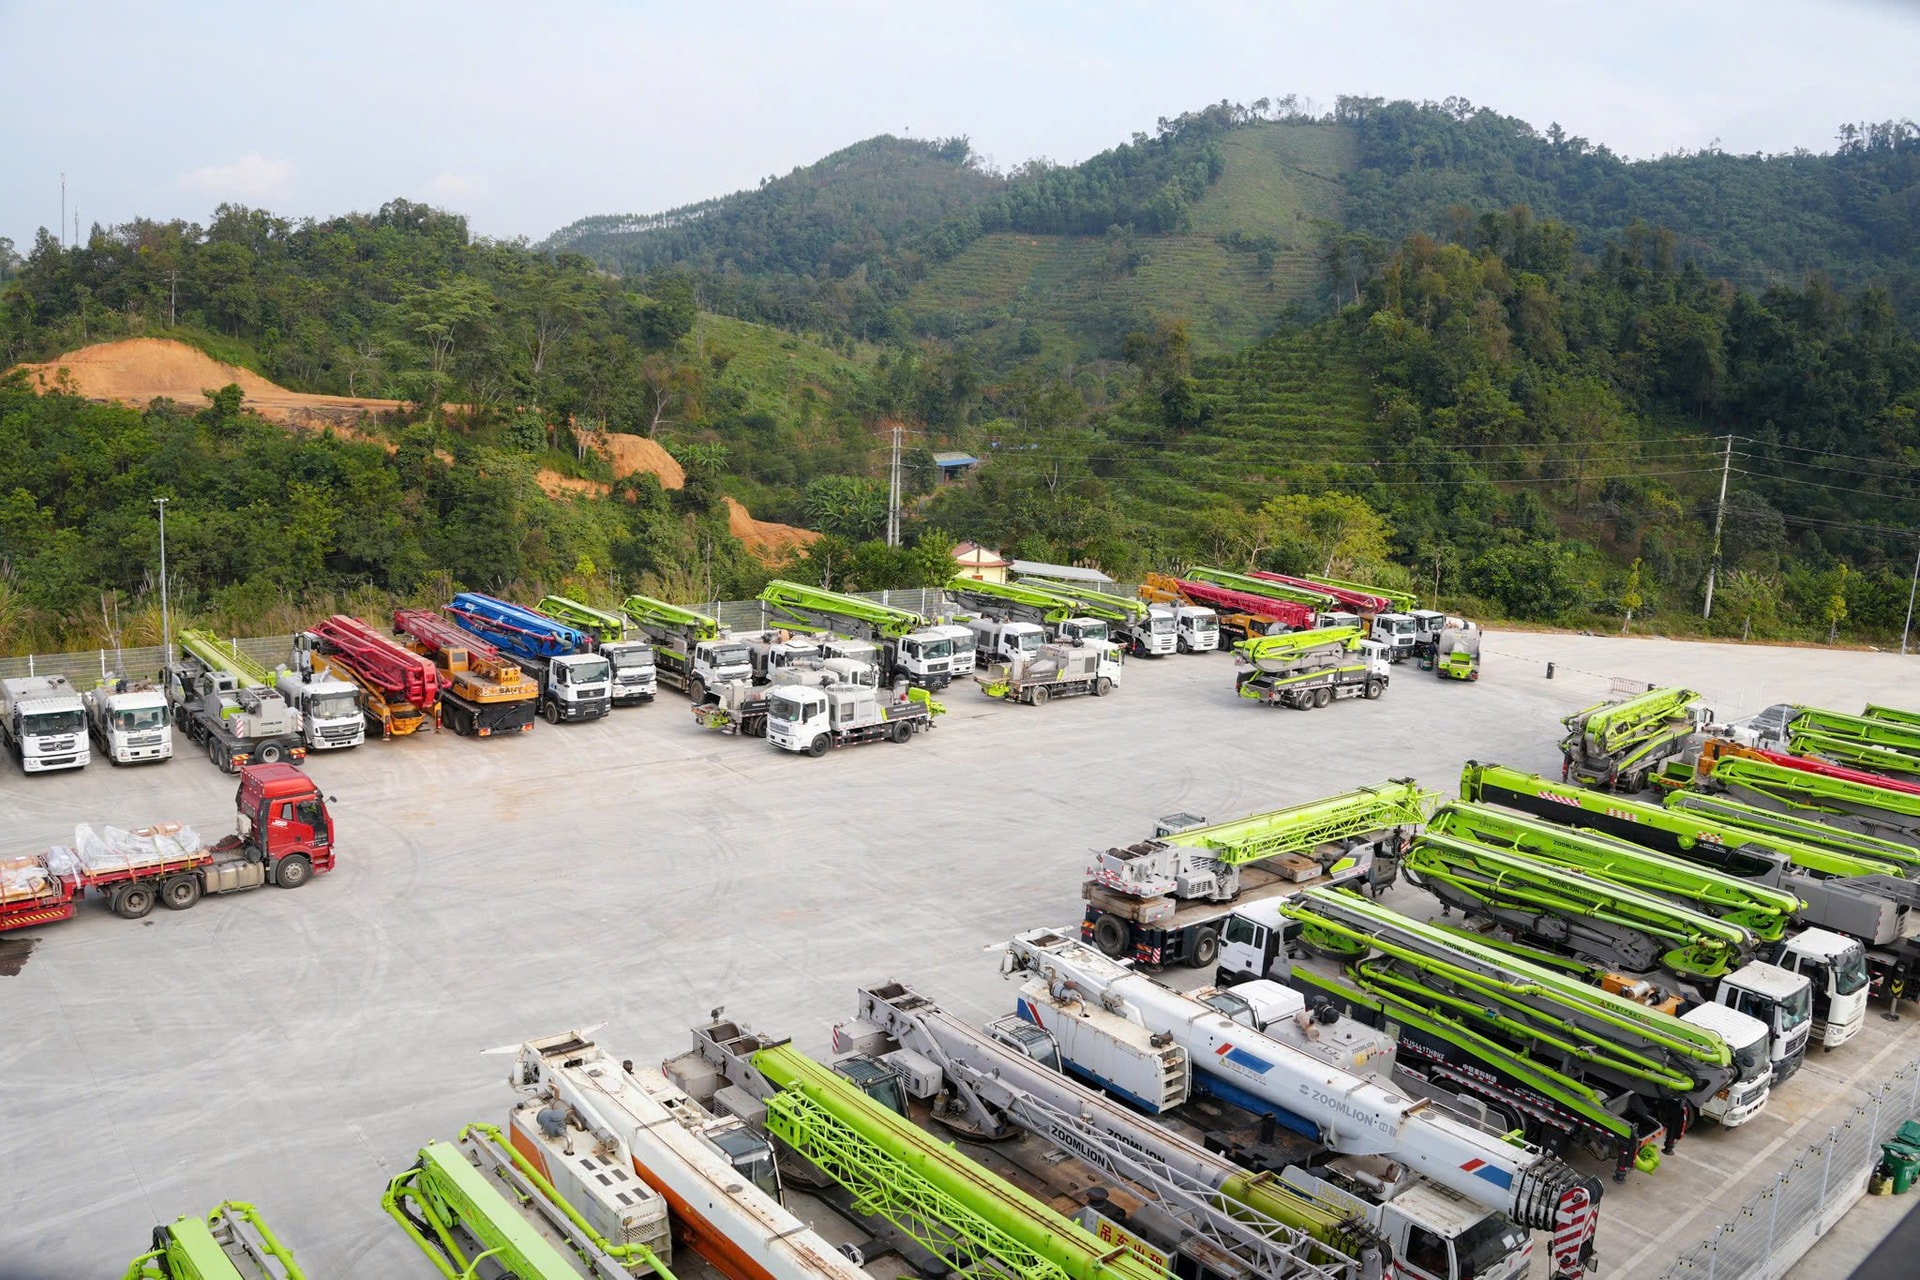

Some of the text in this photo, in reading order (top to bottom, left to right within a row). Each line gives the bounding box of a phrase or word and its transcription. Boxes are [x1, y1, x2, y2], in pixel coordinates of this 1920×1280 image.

[1553, 840, 1583, 852] ZOOMLION
[1548, 879, 1584, 894] ZOOMLION
[1311, 1089, 1374, 1126] ZOOMLION
[1051, 1126, 1105, 1167] ZOOMLION
